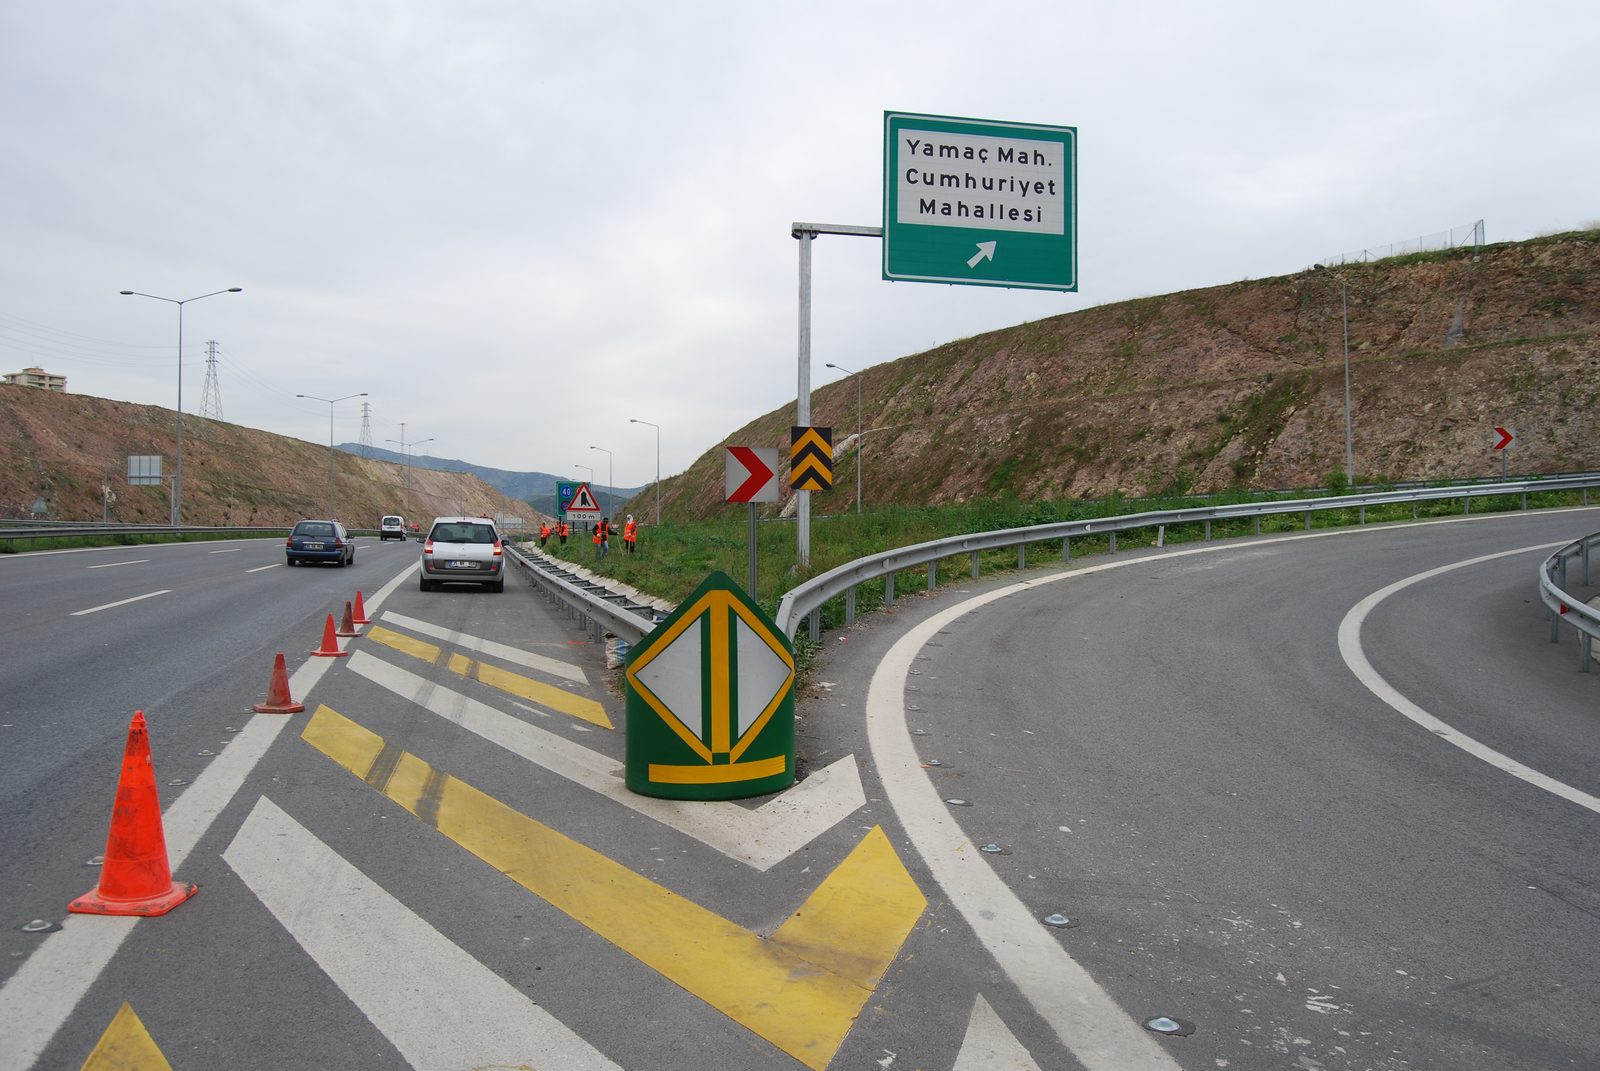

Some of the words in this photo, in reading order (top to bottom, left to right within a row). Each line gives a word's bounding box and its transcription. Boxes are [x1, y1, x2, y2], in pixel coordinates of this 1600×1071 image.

[906, 139, 988, 163] Yamaç
[998, 147, 1052, 166] Mah.
[906, 168, 1056, 197] Cumhuriyet
[919, 198, 1041, 222] Mahallesi
